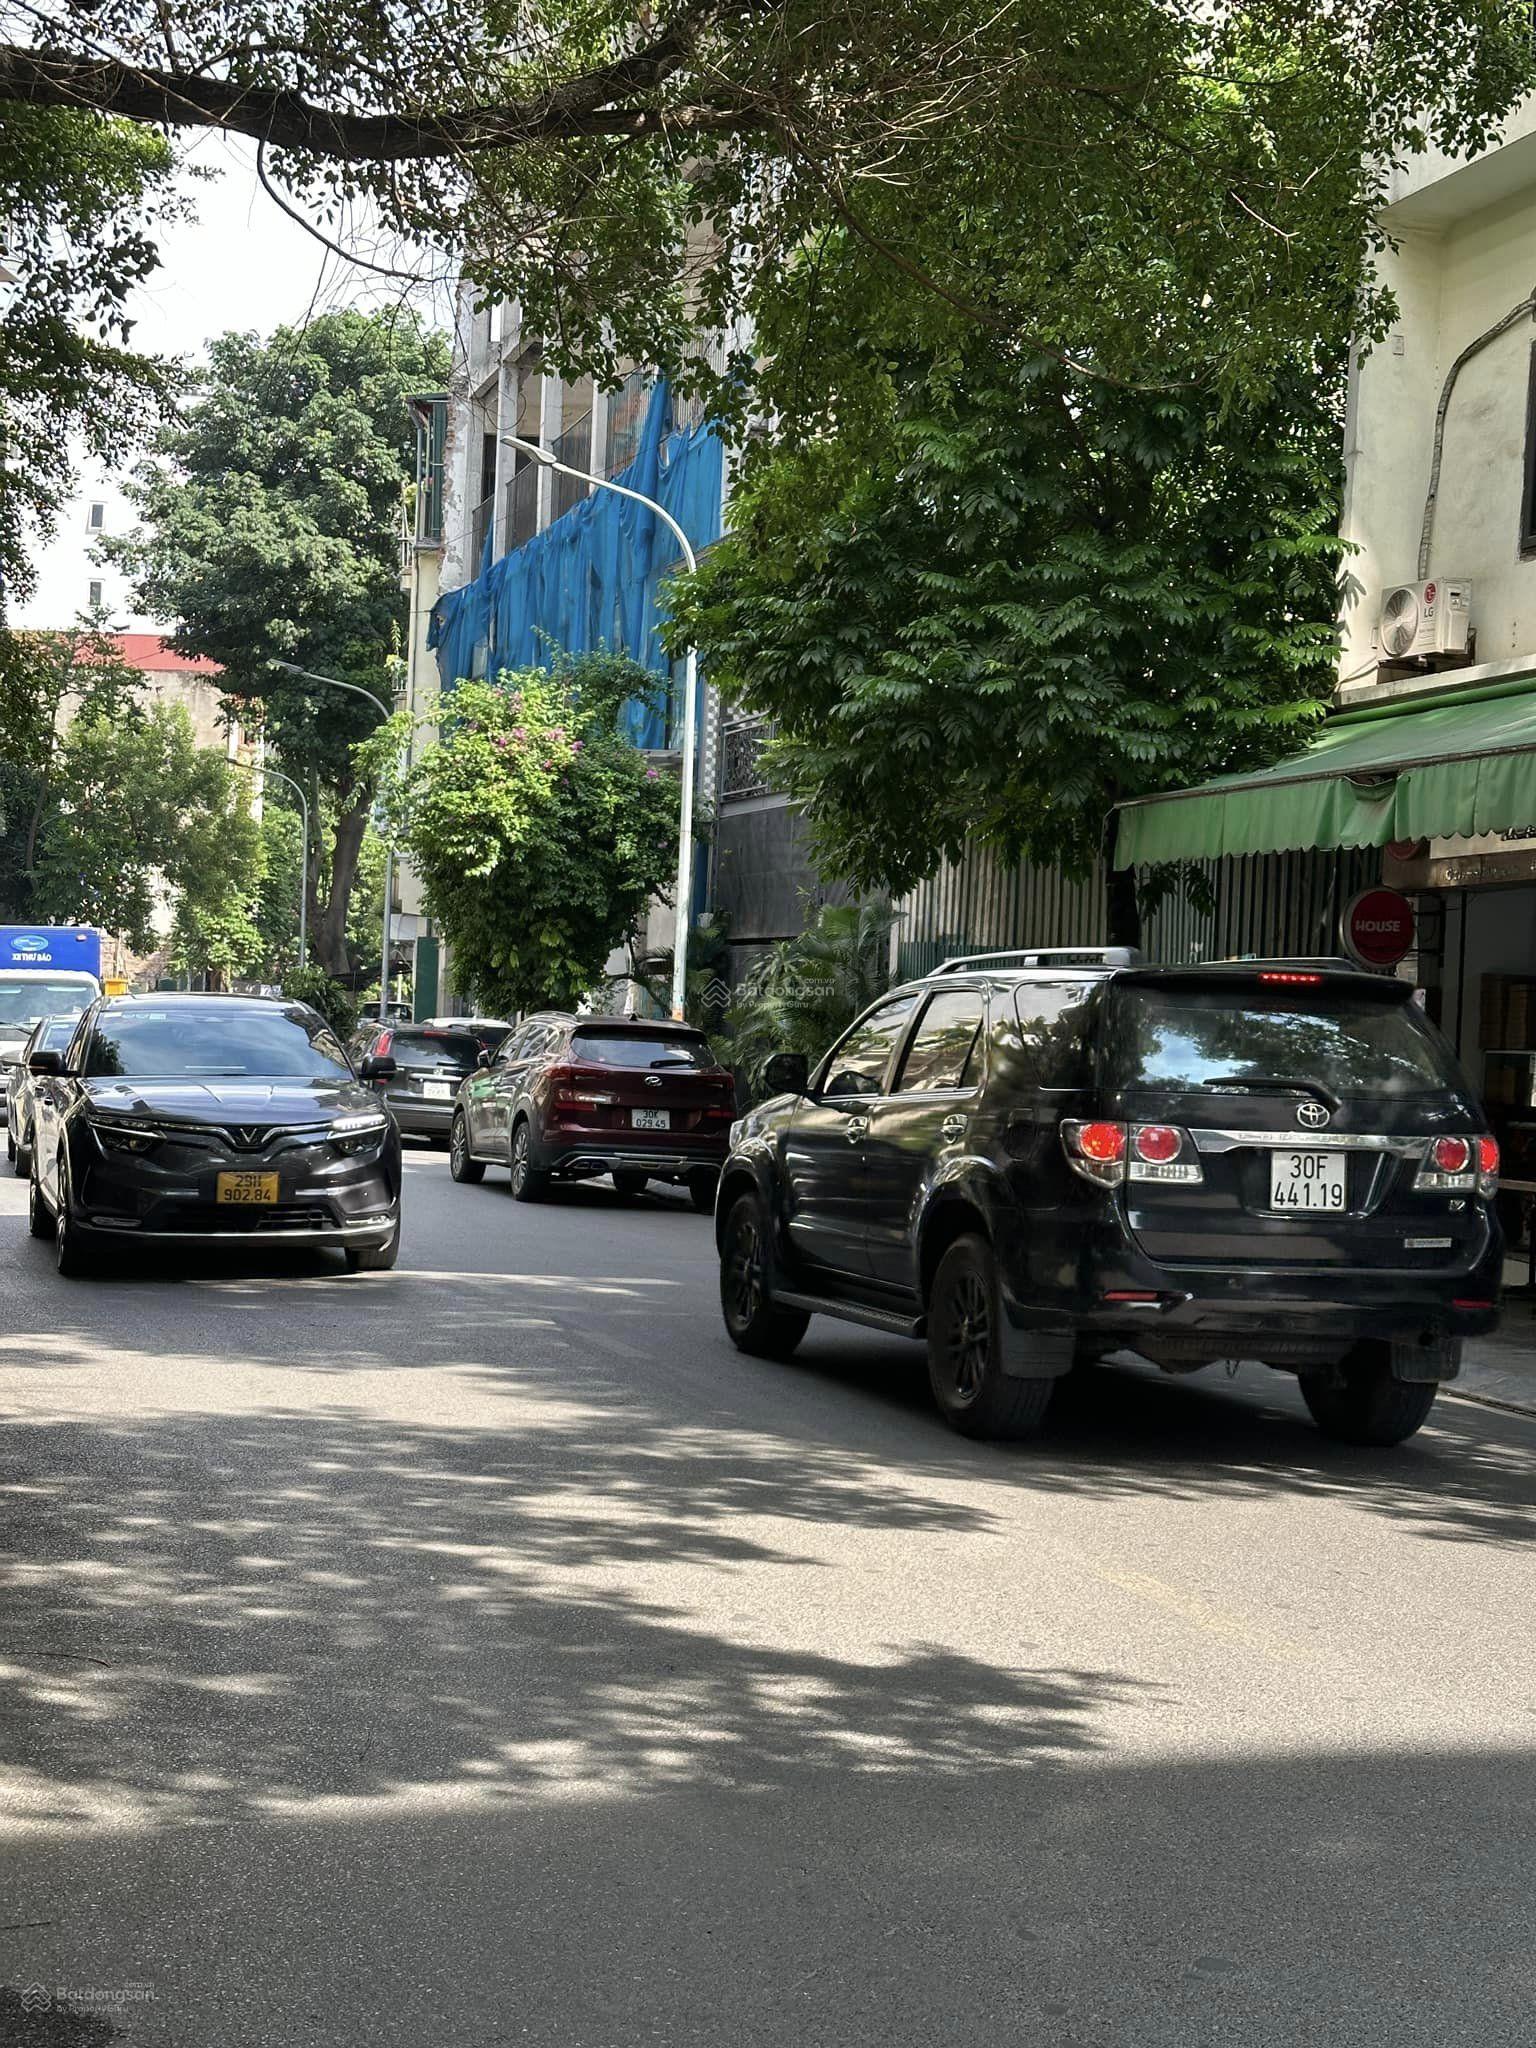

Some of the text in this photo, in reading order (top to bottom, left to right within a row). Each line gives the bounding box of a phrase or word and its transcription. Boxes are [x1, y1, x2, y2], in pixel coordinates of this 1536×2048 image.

[1424, 607, 1434, 618] LG
[1355, 919, 1401, 932] HOUSE
[1290, 1154, 1329, 1179] 30F
[224, 1188, 272, 1201] 902.84
[1274, 1181, 1343, 1207] 441.19
